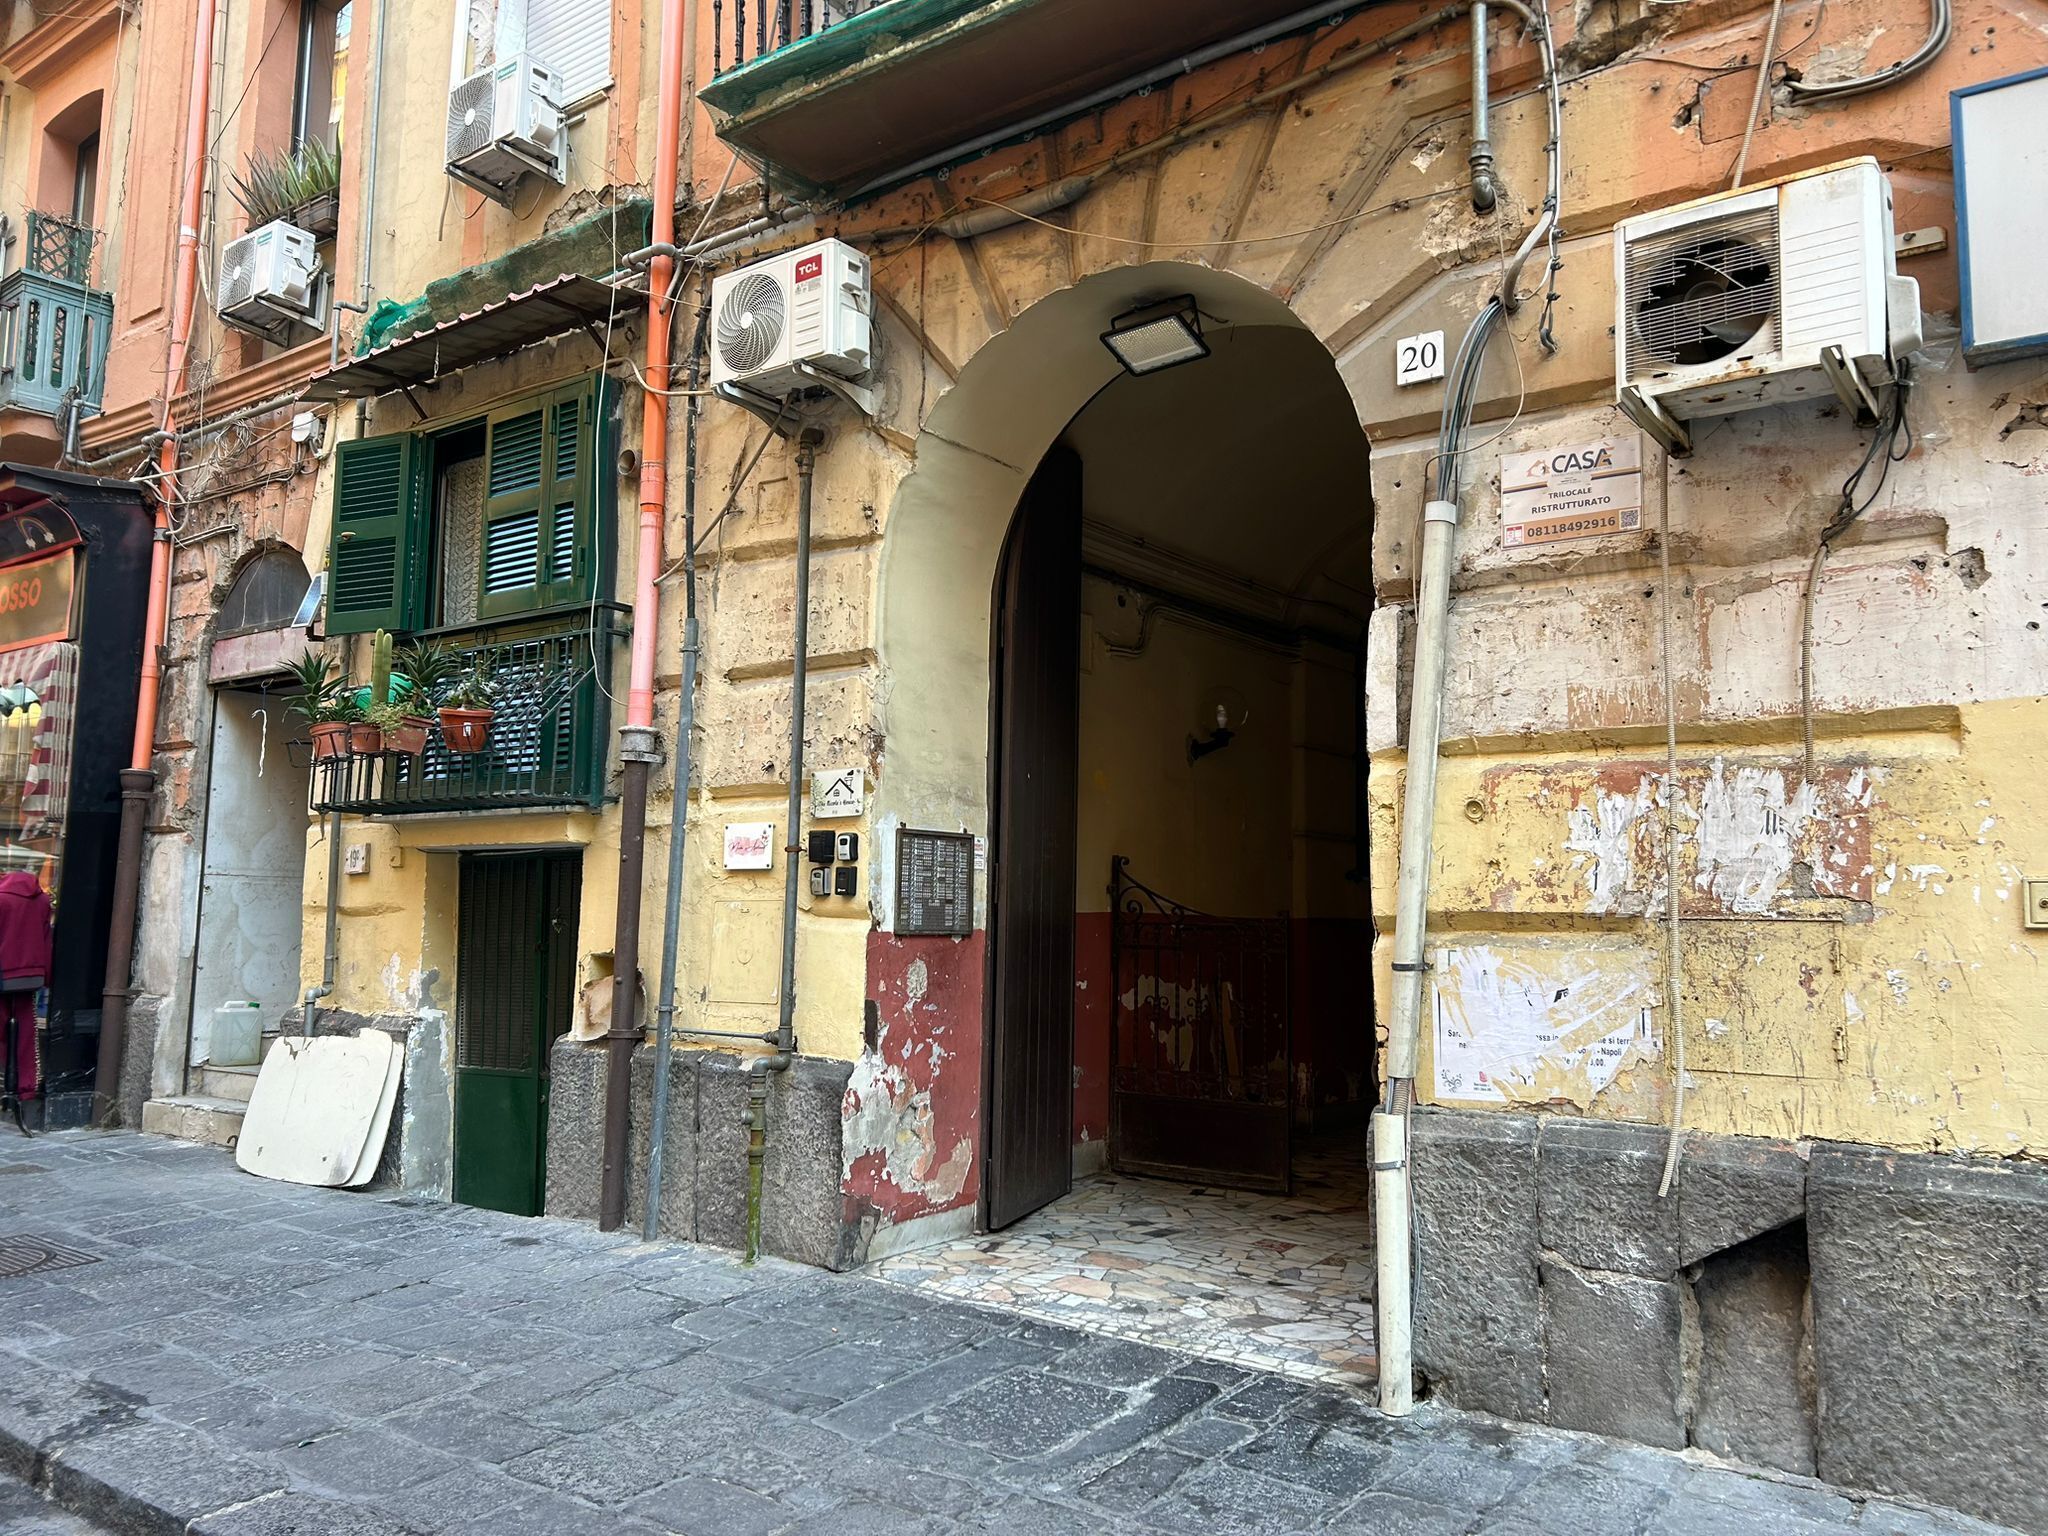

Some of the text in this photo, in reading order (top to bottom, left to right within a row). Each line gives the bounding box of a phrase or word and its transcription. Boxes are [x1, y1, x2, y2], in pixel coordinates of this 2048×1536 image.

[798, 262, 819, 275] TCL
[1402, 341, 1437, 374] 20
[1548, 487, 1593, 499] TRILOCALE
[1531, 495, 1611, 515] RISTRUTTURATO
[1527, 516, 1616, 538] 08118492916
[1601, 1046, 1622, 1057] Napoli
